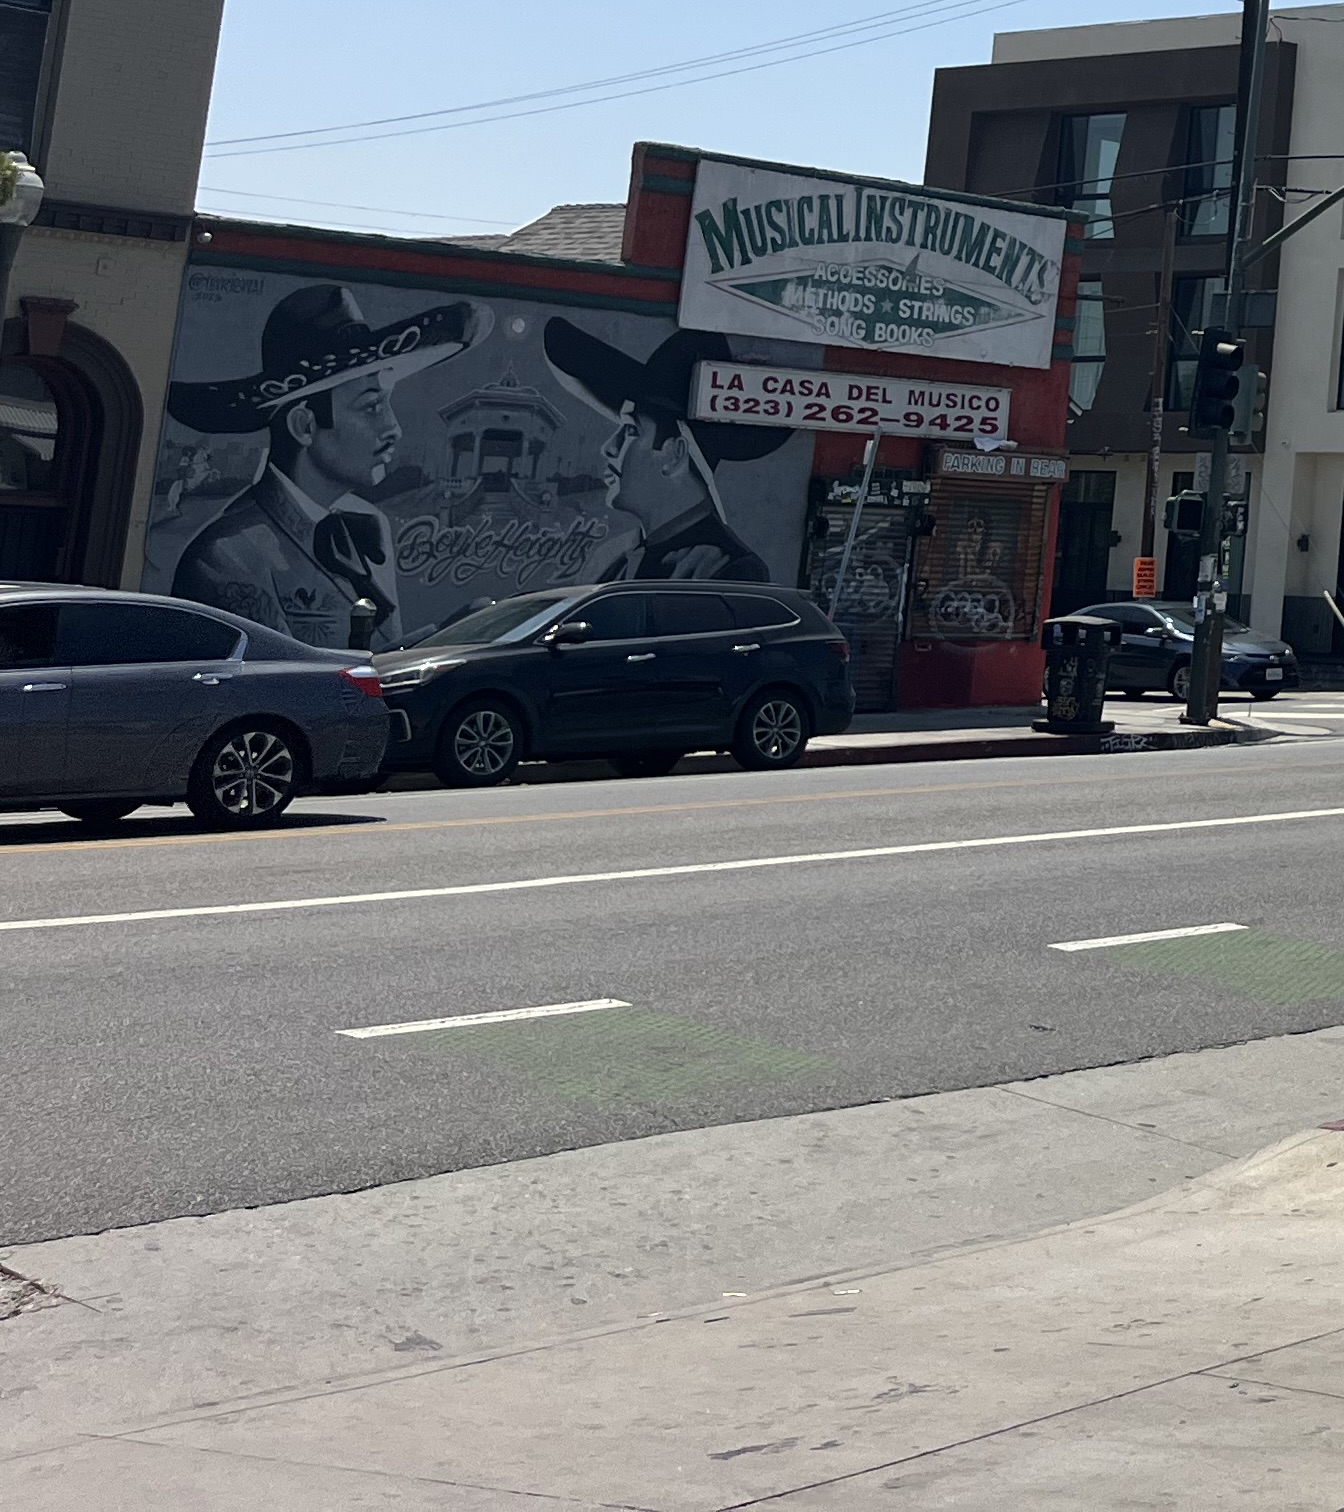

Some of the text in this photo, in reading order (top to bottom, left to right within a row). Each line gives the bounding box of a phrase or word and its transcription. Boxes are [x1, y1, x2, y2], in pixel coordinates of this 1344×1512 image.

[781, 283, 976, 326] METHODS STRINGS
[812, 314, 936, 348] SONG BOOKS
[710, 370, 1001, 413] LA CASA DEL MUSICO
[709, 394, 1000, 435] (323) 262-9425
[942, 452, 1005, 475] PARKING
[1010, 457, 1025, 476] IN
[397, 514, 609, 587] Boyle Heights
